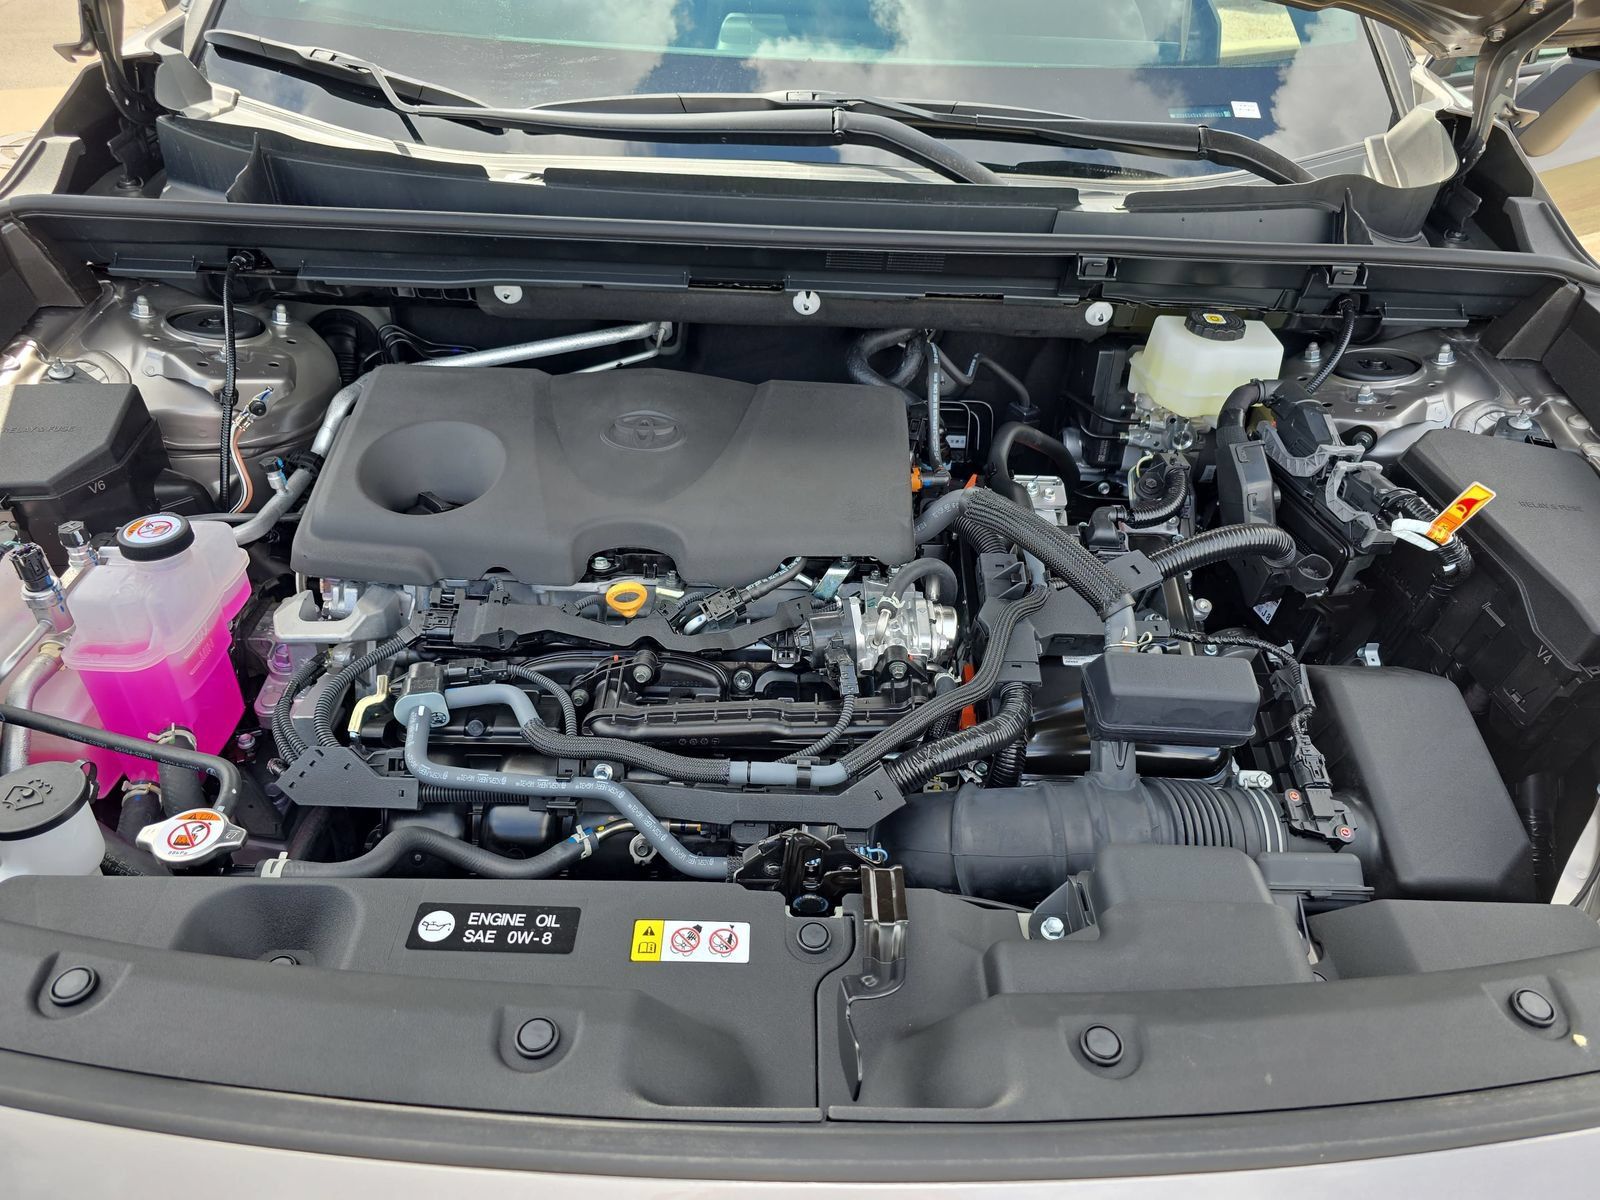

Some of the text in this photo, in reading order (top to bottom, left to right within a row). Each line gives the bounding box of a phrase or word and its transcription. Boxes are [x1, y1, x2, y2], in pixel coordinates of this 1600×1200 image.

[88, 480, 106, 494] V6
[1537, 644, 1553, 665] V4
[467, 912, 561, 928] ENGINE OIL
[462, 929, 553, 945] SAE 0W-8
